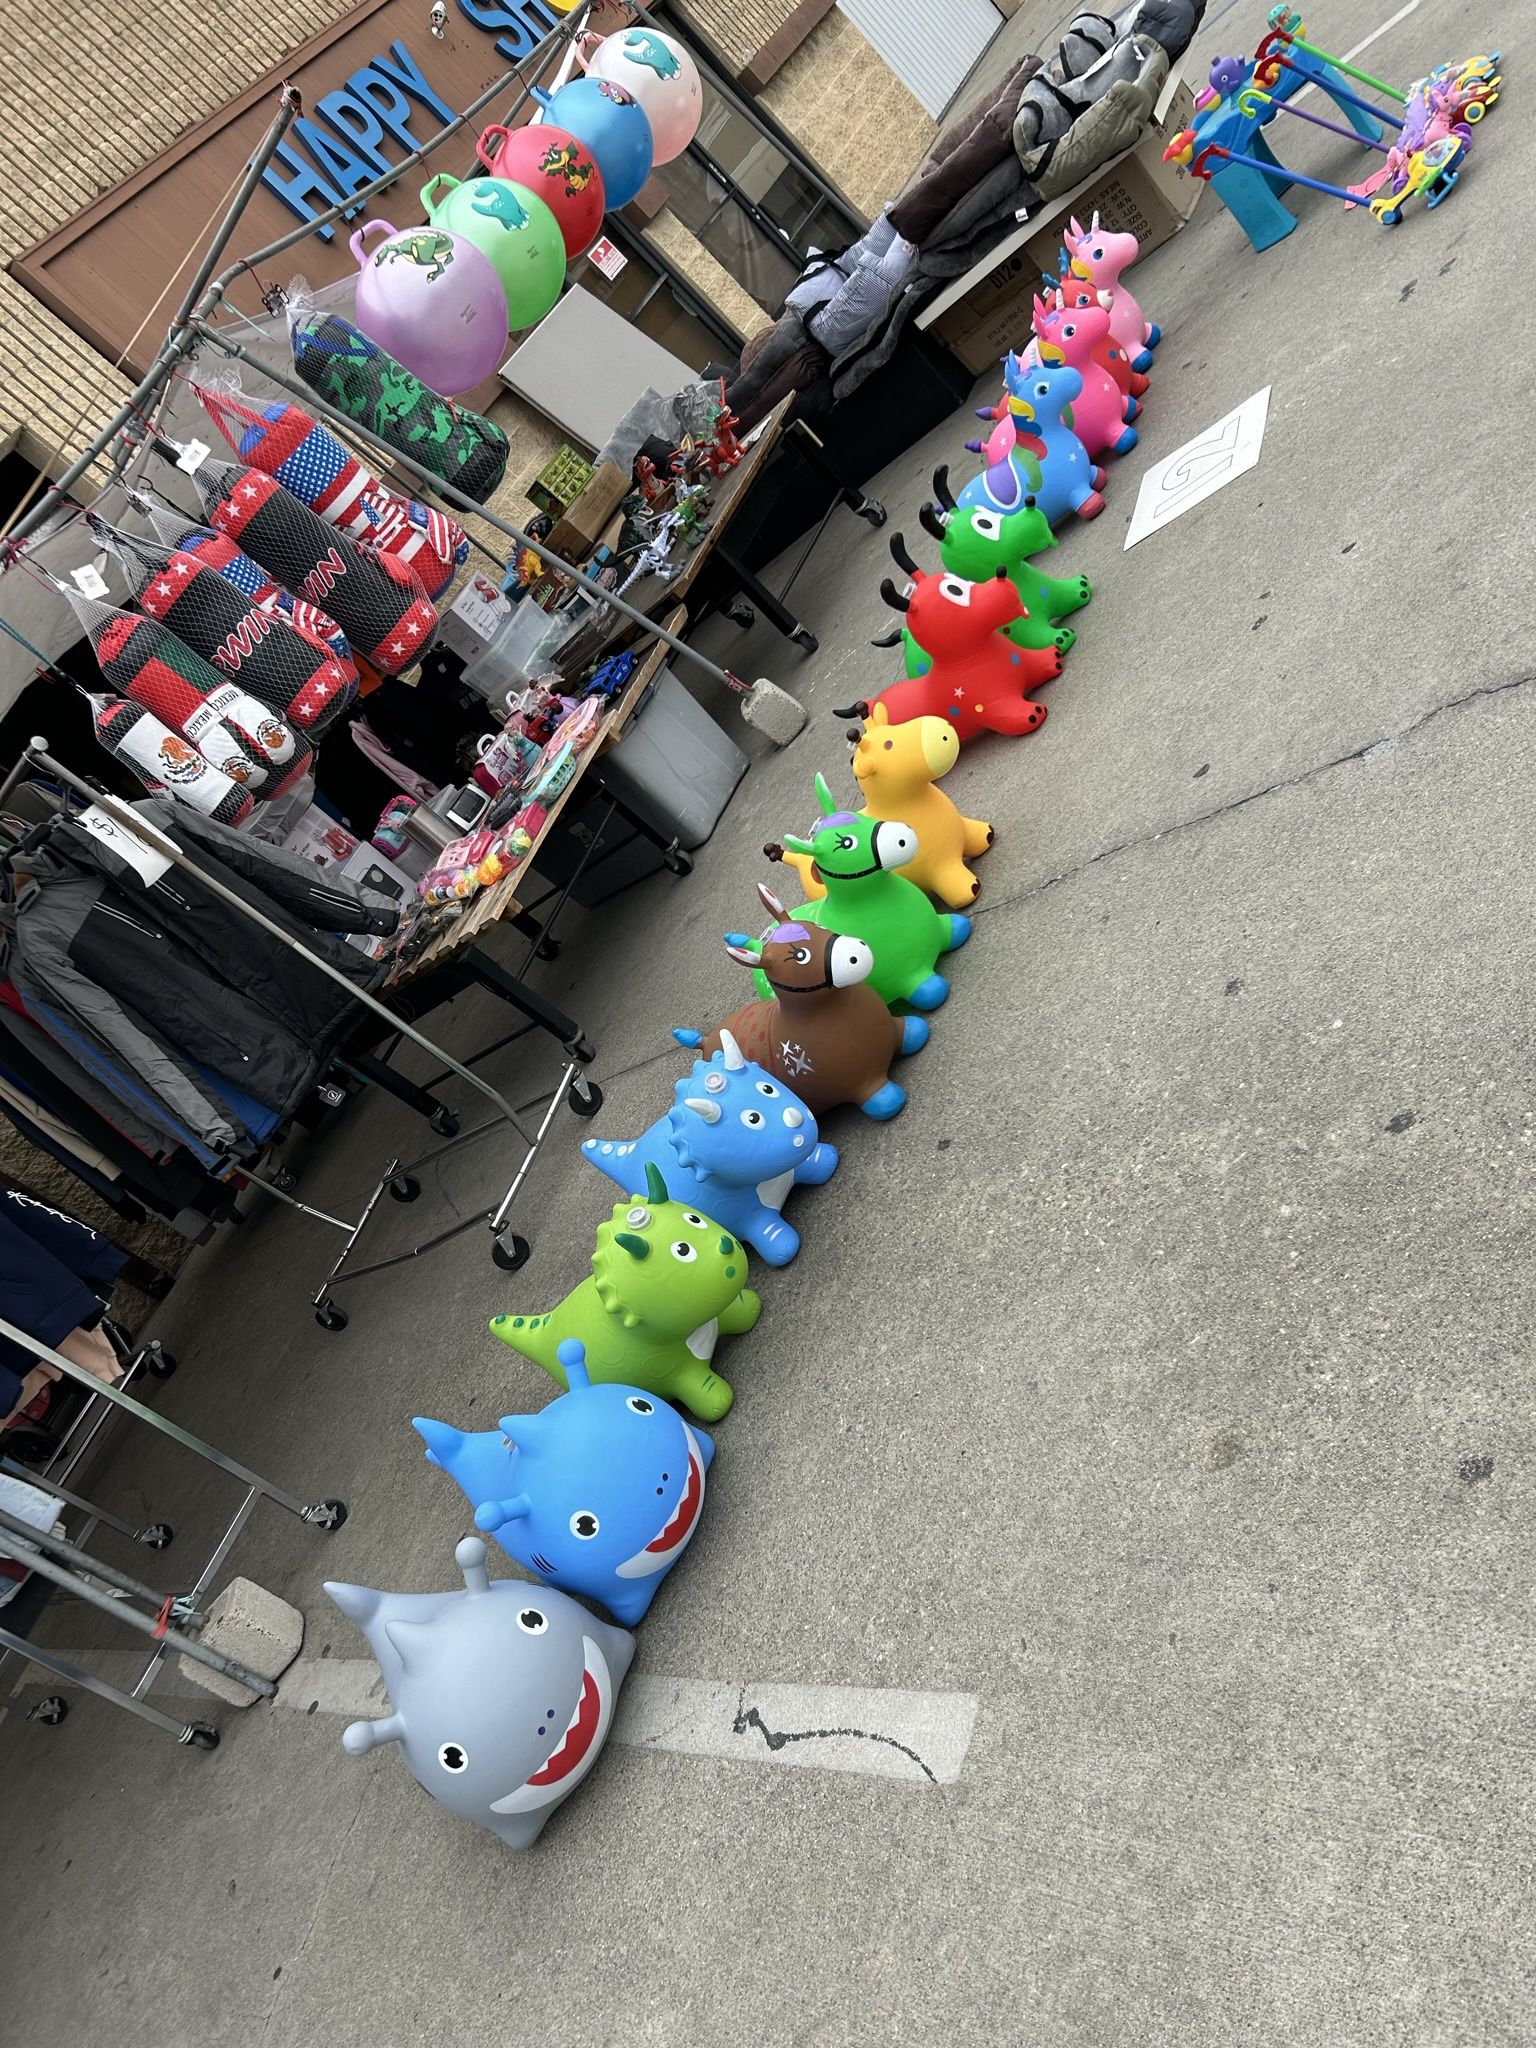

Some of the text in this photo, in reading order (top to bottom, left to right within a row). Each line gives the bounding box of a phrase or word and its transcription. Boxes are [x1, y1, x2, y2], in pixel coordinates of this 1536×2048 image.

[249, 39, 462, 243] HAPPY
[211, 689, 239, 712] MEXICO
[185, 708, 214, 740] MEXICO
[89, 817, 154, 855] $1
